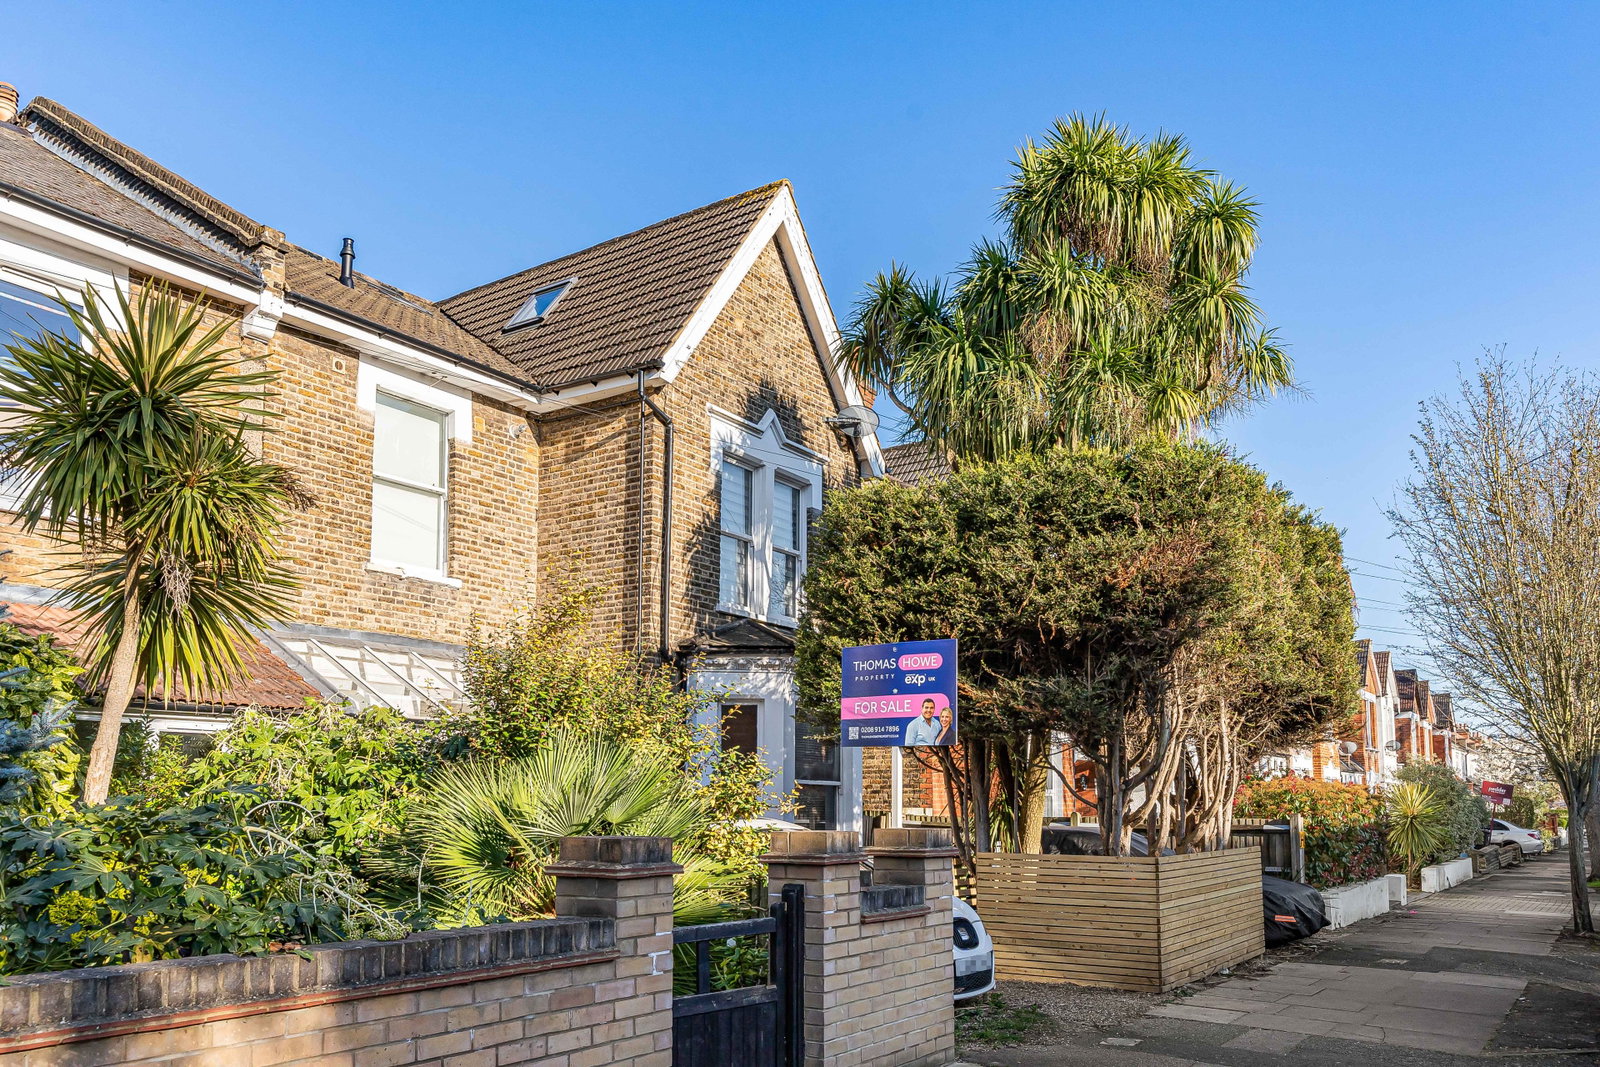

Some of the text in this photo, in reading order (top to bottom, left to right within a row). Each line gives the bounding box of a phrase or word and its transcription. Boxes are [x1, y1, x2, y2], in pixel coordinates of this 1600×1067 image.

[853, 655, 938, 671] THOMAS HOWE
[855, 673, 895, 681] PROPERTY
[854, 699, 912, 714] FOR SALE
